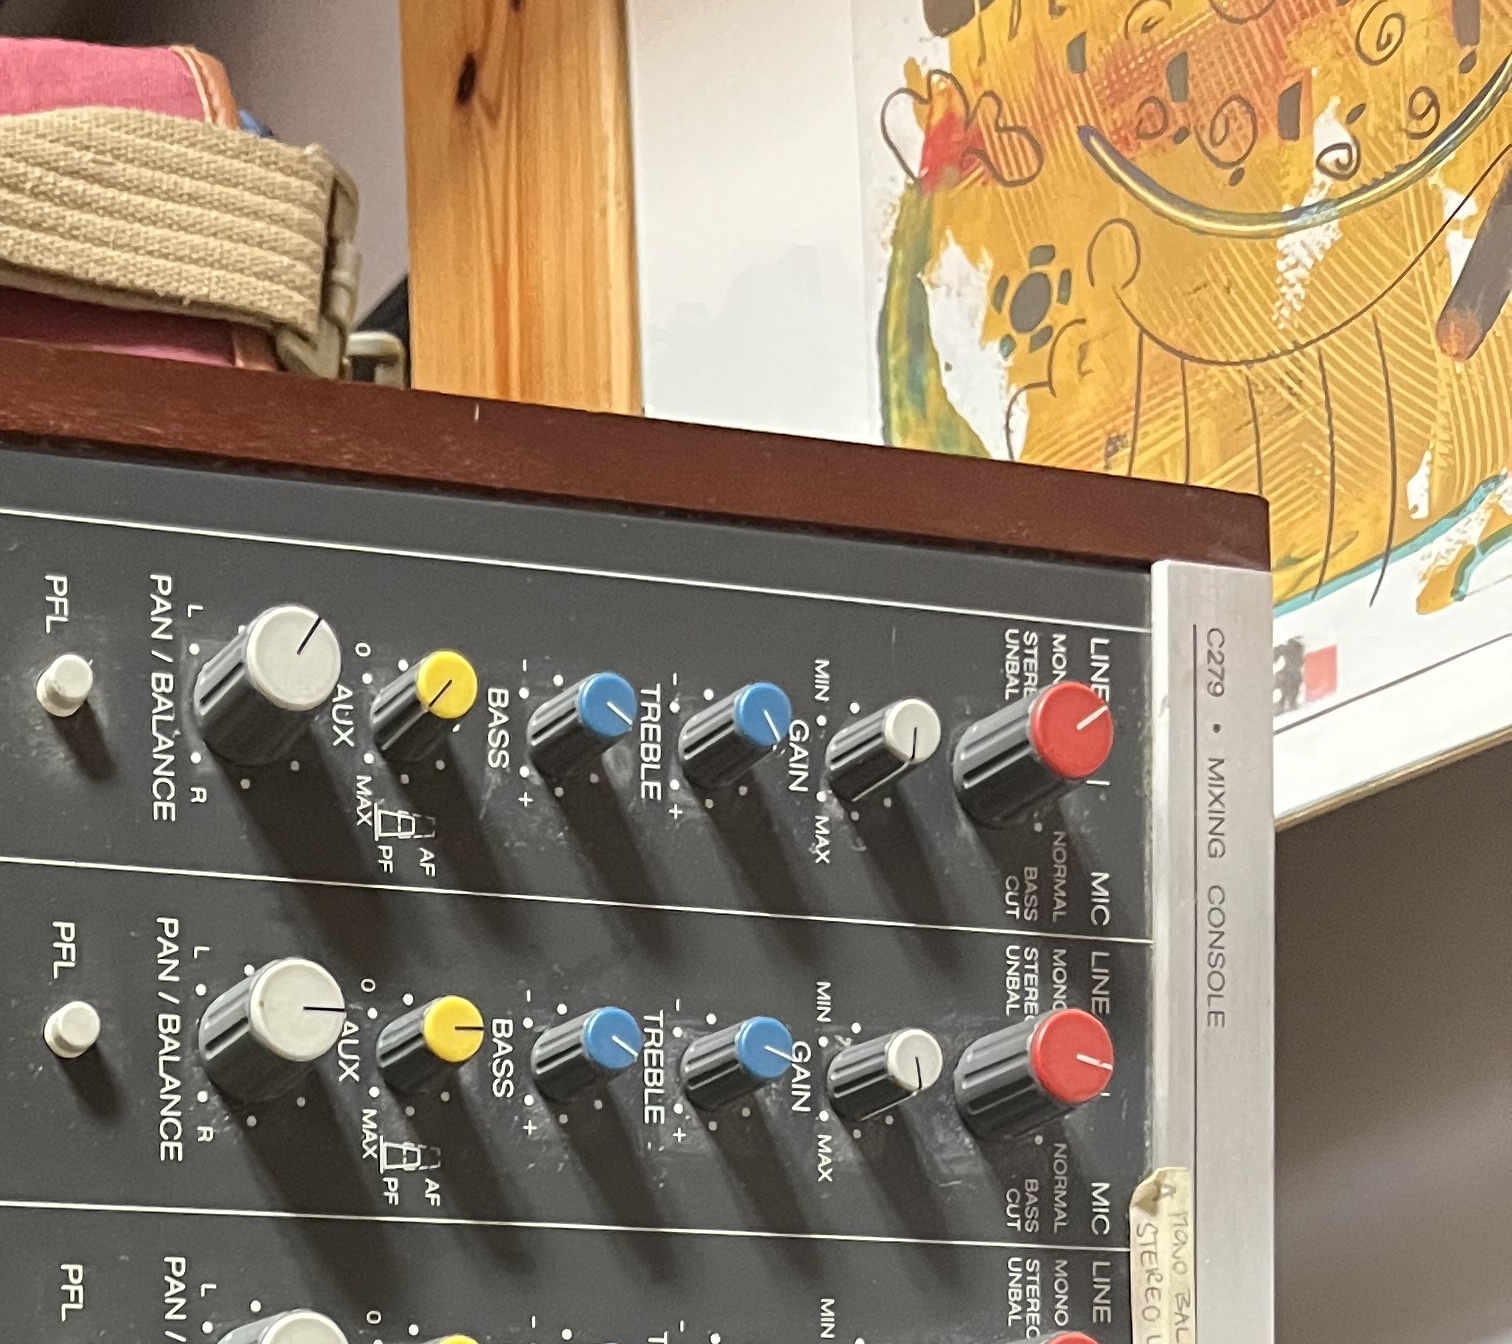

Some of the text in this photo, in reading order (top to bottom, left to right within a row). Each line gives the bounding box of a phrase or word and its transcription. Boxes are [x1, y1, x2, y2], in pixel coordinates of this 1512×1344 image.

[45, 575, 68, 633] PFL
[150, 575, 175, 821] PAN BALANCE
[815, 660, 829, 701] MIN
[332, 683, 354, 746] AUX
[488, 688, 509, 768] BASS
[641, 684, 661, 800] TREBLE
[789, 720, 809, 791] GAIN
[1090, 638, 1109, 925] LINE MIC
[357, 775, 372, 826] MAX
[1207, 628, 1225, 1027] C279 MIXING CONSOLE
[378, 845, 393, 873] PF
[420, 848, 435, 876] AF
[814, 816, 830, 863] MAX
[1053, 831, 1066, 922] NORMAL
[53, 922, 75, 978] PFL
[157, 918, 182, 1161] PAN BALANCE
[493, 1019, 514, 1097] BASS
[644, 1010, 665, 1124] TREBLE
[790, 1041, 811, 1111] GAIN
[1091, 1183, 1110, 1234] MIC
[61, 1264, 83, 1321] PFL
[164, 1257, 186, 1319] PAN
[1008, 1258, 1022, 1326] UNBAL
[1055, 1260, 1068, 1326] MONO
[1093, 1262, 1111, 1323] LINE
[1136, 1223, 1163, 1322] STEREO
[821, 1299, 835, 1338] MIN
[1174, 1289, 1191, 1343] BAL
